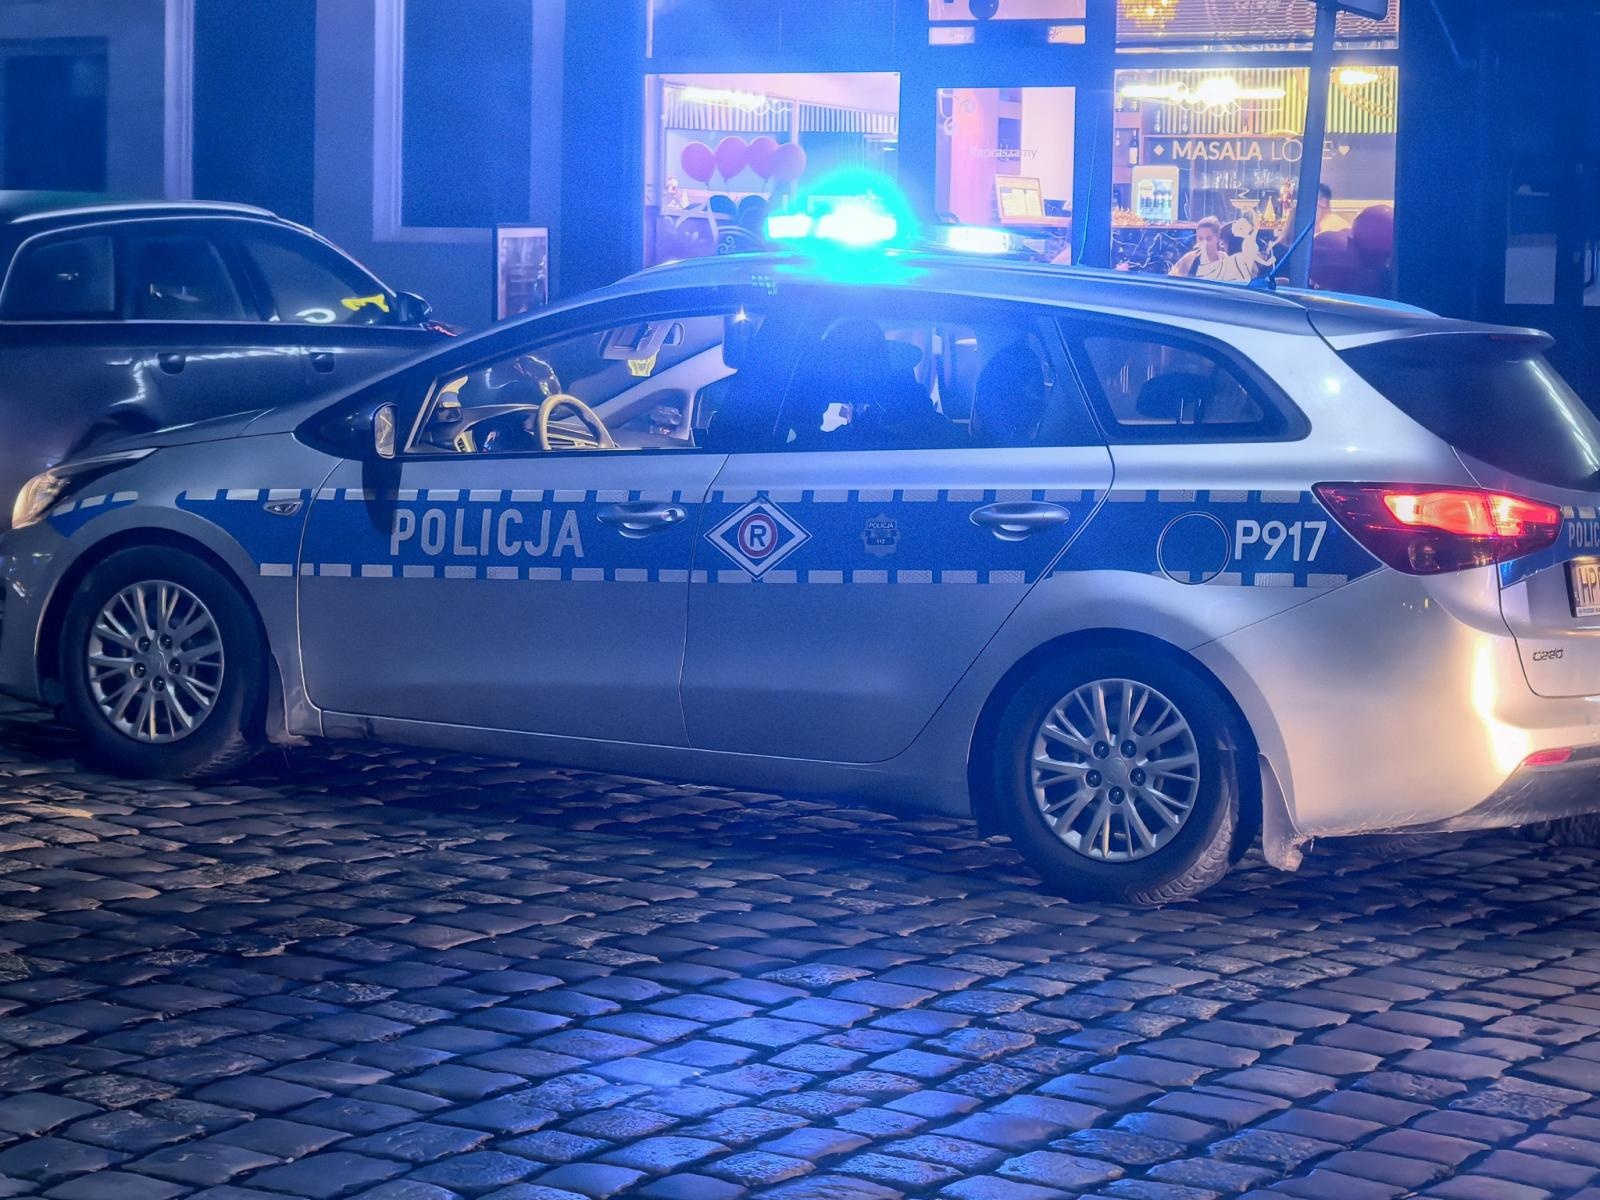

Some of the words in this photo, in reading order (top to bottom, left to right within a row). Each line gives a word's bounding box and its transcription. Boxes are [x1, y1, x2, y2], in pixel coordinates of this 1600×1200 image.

[1172, 140, 1263, 161] MASALA
[1272, 140, 1333, 162] LOE
[390, 508, 585, 557] POLICJA
[749, 524, 767, 547] R
[1235, 519, 1327, 561] P917
